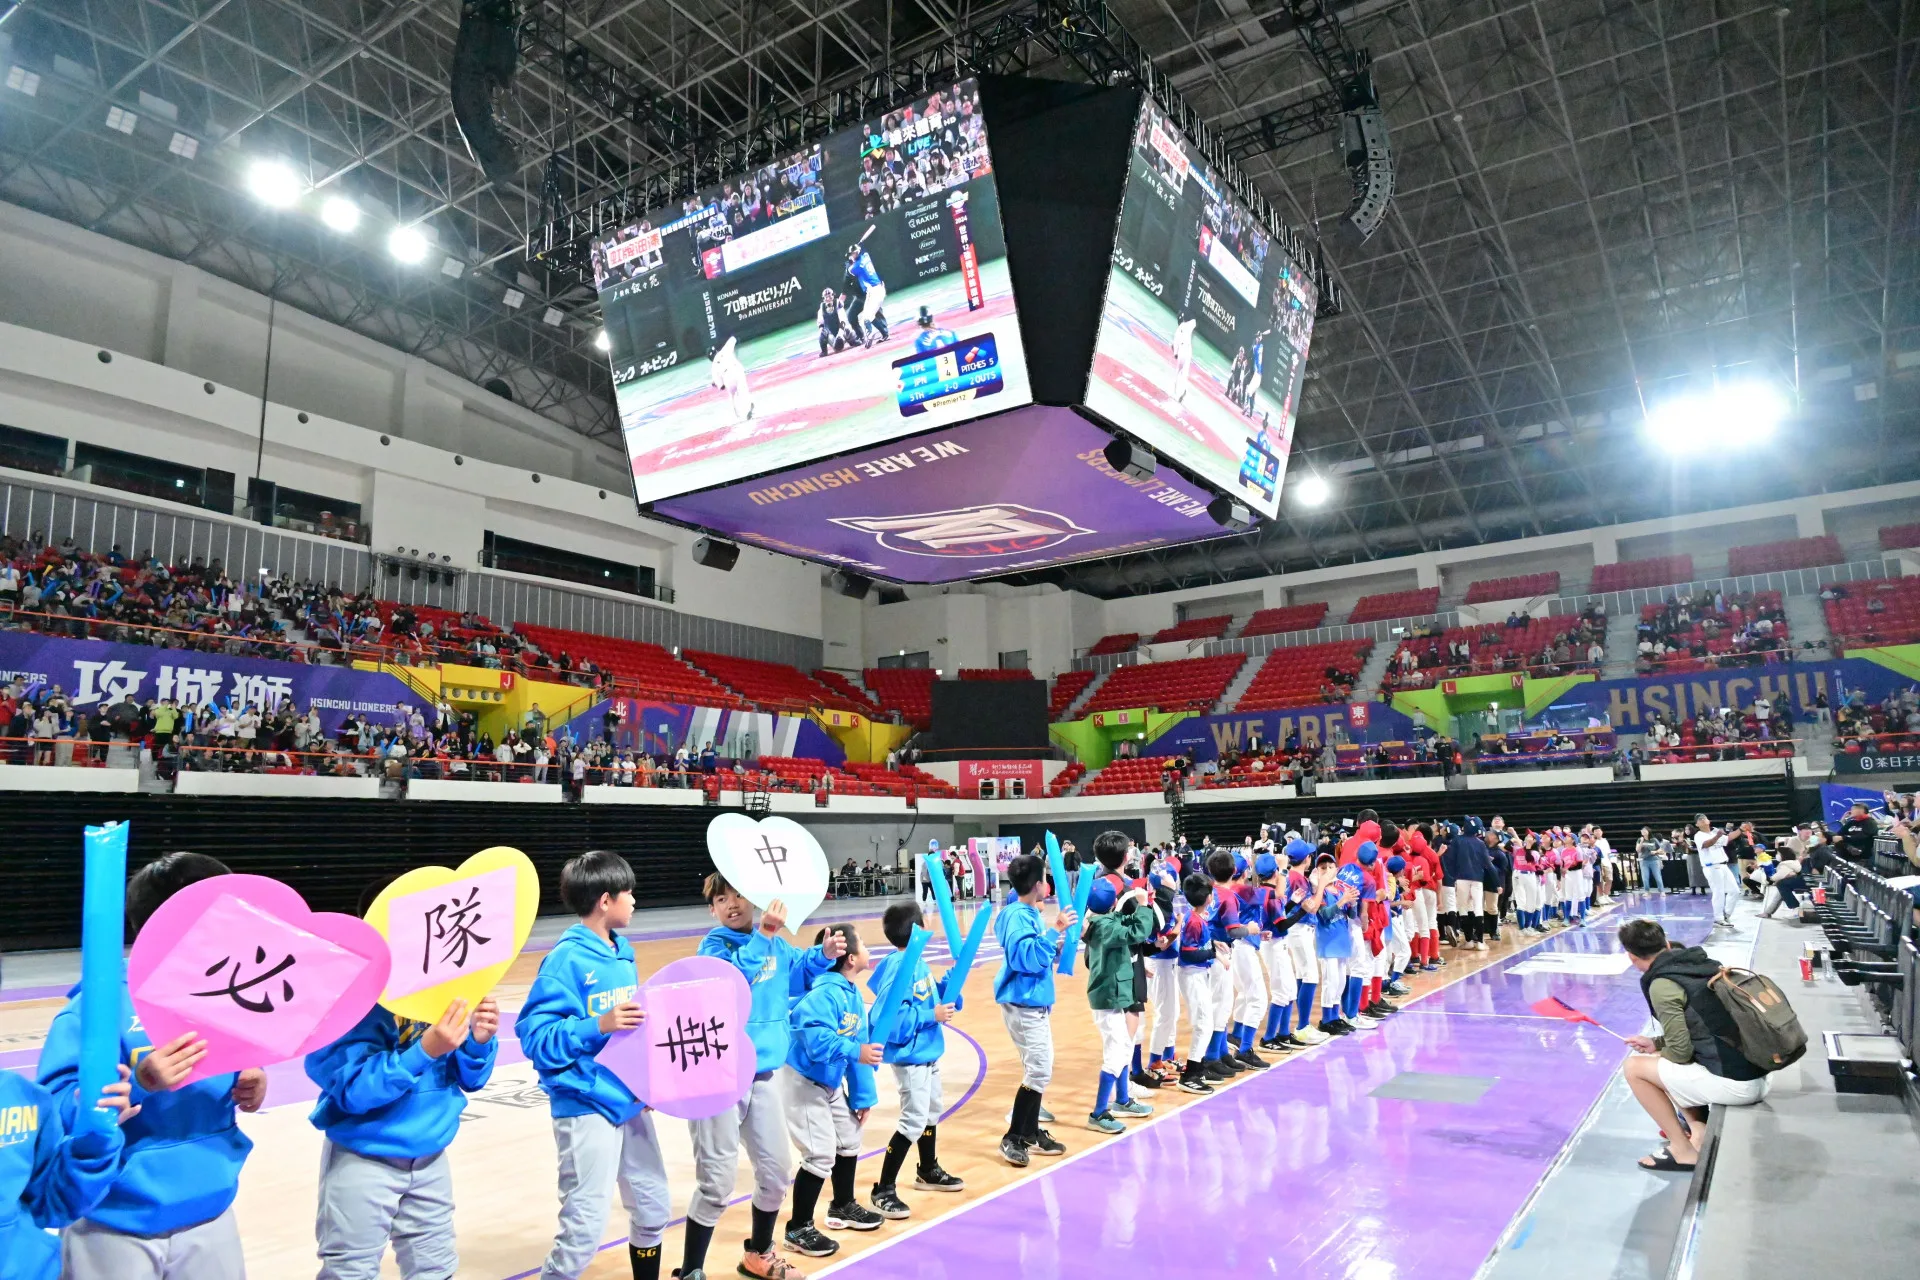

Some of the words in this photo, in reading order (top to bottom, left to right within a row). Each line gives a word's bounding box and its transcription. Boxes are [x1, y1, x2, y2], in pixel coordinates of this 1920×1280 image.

[908, 135, 931, 155] LIVE
[911, 224, 940, 239] KONAMI
[717, 289, 739, 301] KONAMI
[748, 296, 793, 317] ANNIVERSARY
[640, 350, 677, 376] オービック
[911, 364, 926, 374] TPE
[943, 356, 949, 365] 3
[961, 359, 986, 373] PITCHES
[989, 357, 994, 366] 5
[914, 377, 928, 387] JPN
[946, 369, 951, 377] 4
[944, 382, 959, 393] 2-0
[932, 394, 966, 408] #Premier12
[910, 440, 970, 463] WE
[854, 452, 916, 478] ARE
[748, 467, 861, 505] HSINCHU
[1148, 487, 1192, 506] ARE
[0, 670, 47, 684] NEERS
[503, 674, 511, 690] J
[1513, 675, 1524, 687] M
[72, 660, 293, 717] 攻城獅
[1445, 682, 1454, 693] L
[310, 698, 351, 710] HSINCHU
[353, 702, 398, 713] LIONEERS
[1610, 671, 1828, 727] HSINCHU
[1094, 715, 1103, 725] K
[1352, 704, 1366, 719] 東
[851, 715, 858, 728] K
[1876, 755, 1920, 769] 茶日子
[754, 834, 788, 886] 中
[422, 886, 491, 973] 隊
[190, 945, 295, 1013] 必
[655, 1014, 729, 1072] 華
[637, 1247, 656, 1258] SG
